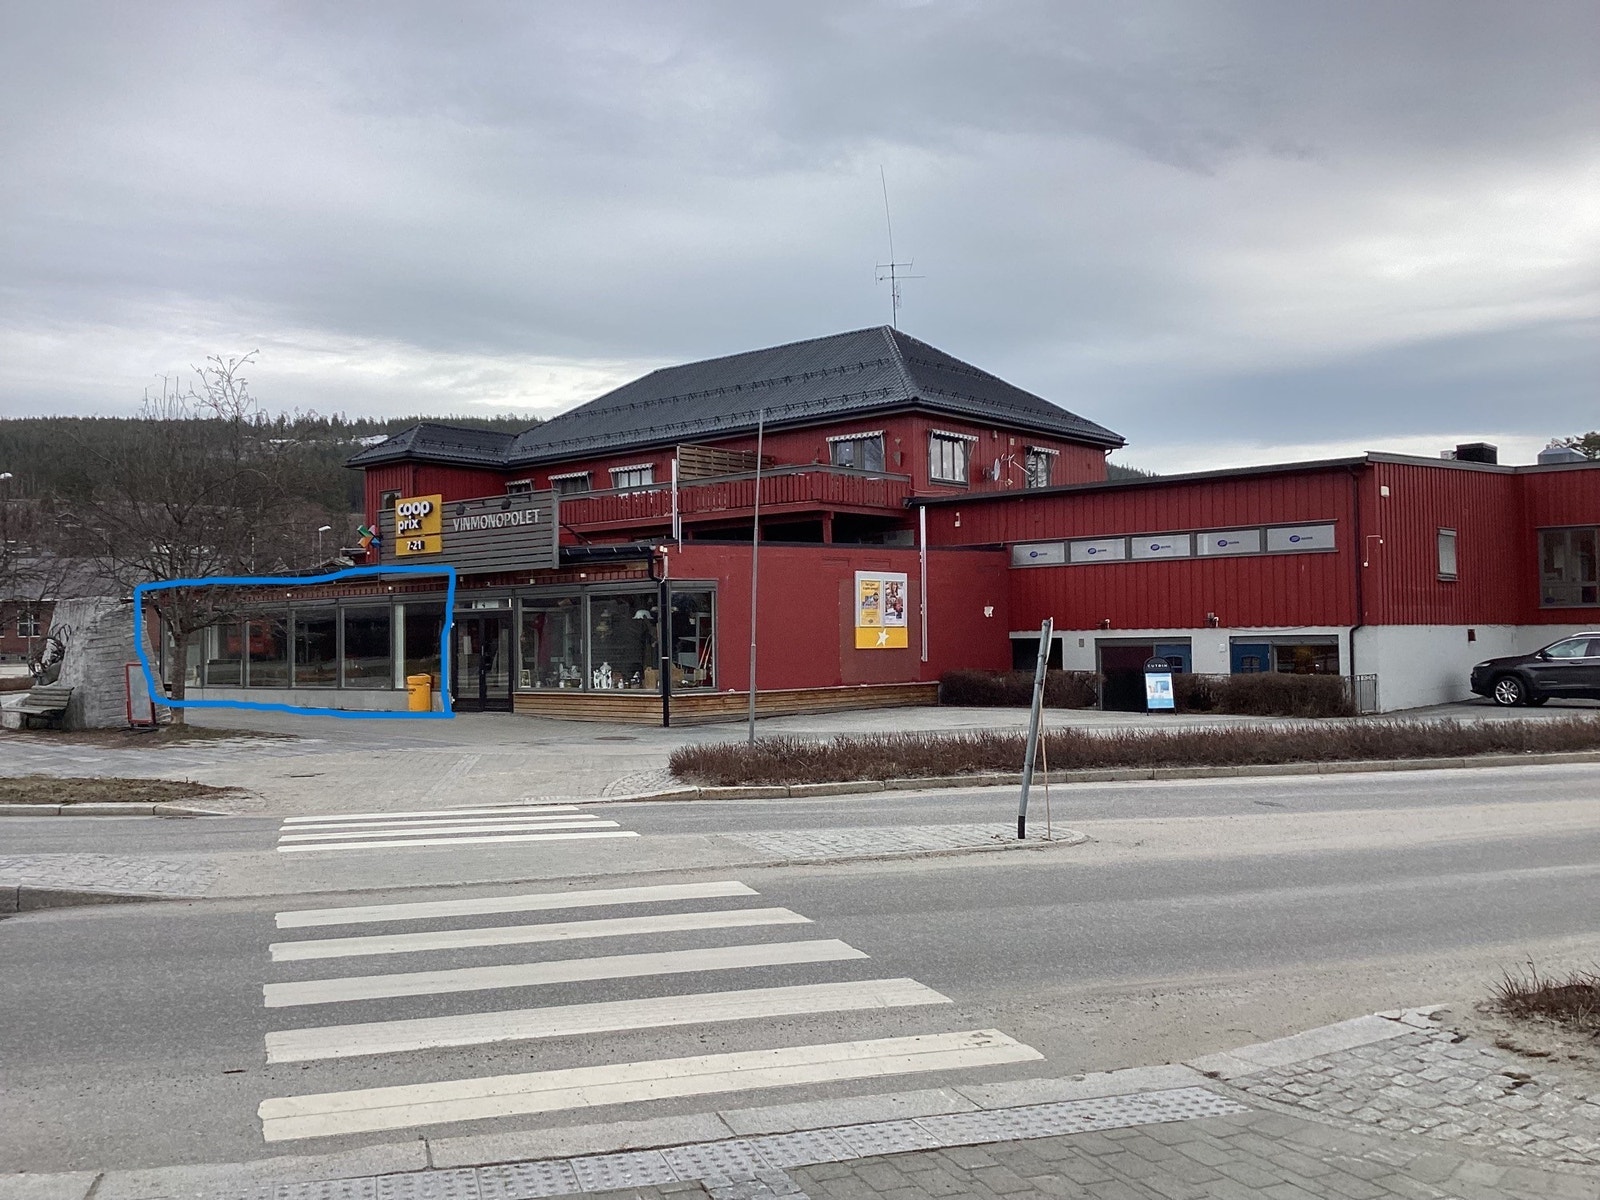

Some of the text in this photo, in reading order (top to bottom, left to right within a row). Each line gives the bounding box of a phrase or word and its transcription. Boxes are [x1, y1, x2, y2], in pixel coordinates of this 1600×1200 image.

[397, 500, 431, 517] coop
[397, 516, 420, 535] prix
[453, 509, 540, 532] VINMONOPOLET
